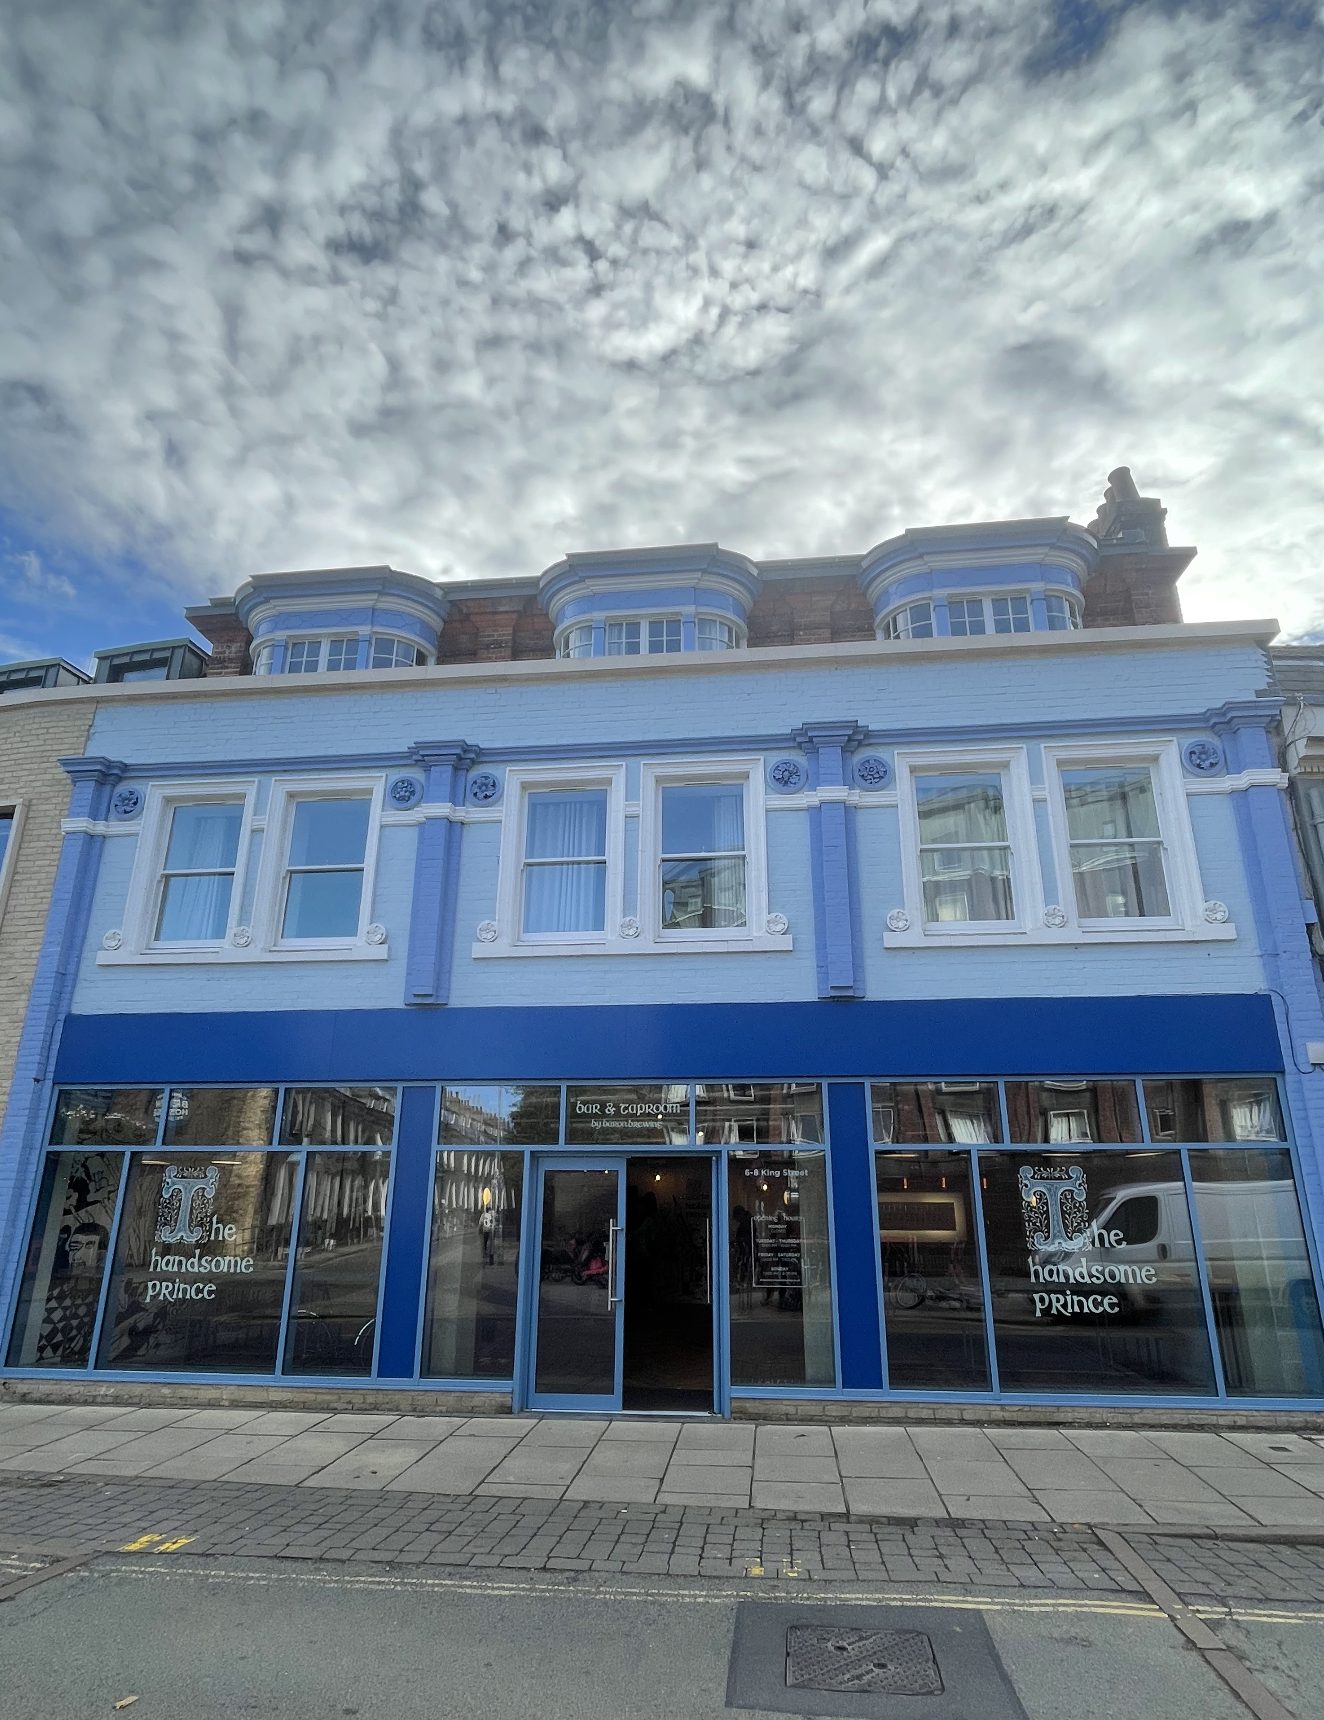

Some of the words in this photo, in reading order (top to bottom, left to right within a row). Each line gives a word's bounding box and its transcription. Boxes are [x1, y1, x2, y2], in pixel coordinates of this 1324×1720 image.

[605, 1102, 616, 1115] &
[591, 1119, 602, 1129] by
[744, 1168, 759, 1176] 6-8
[761, 1168, 780, 1177] King
[782, 1168, 809, 1176] Street
[149, 1247, 254, 1273] handsome
[1028, 1255, 1158, 1284] handsome
